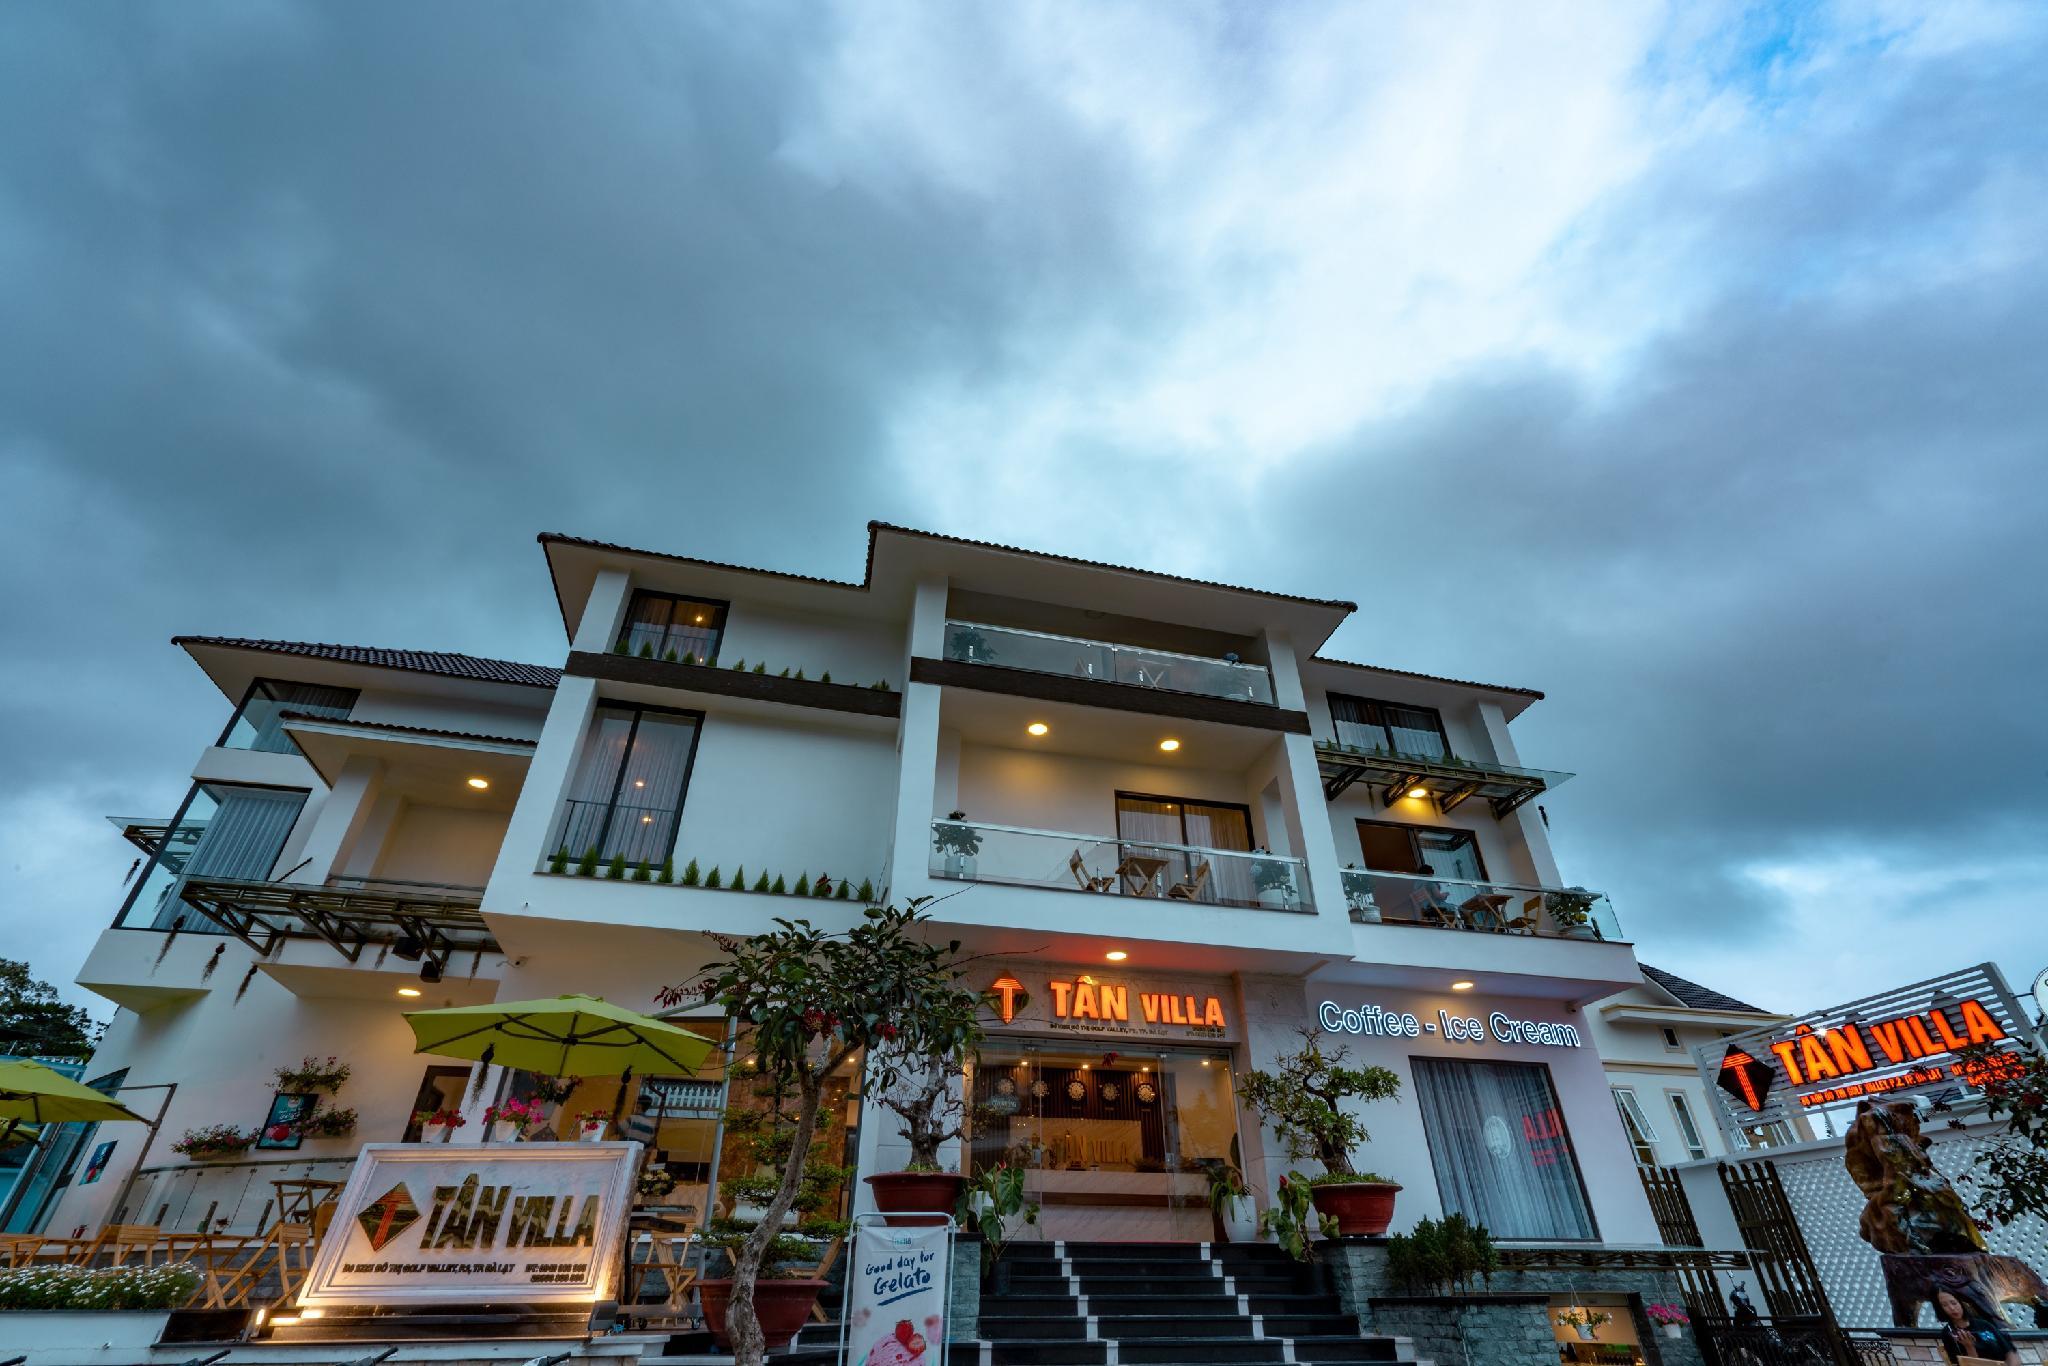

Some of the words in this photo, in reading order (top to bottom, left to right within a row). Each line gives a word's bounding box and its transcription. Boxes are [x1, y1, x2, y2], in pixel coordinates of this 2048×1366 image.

[1050, 975, 1128, 1021] TÂN
[1140, 993, 1226, 1026] VILLA
[1319, 1000, 1420, 1037] Coffee
[1439, 1009, 1484, 1040] Ice
[1489, 1012, 1581, 1048] Cream
[1770, 1023, 1876, 1086] TÂN
[1870, 1000, 2009, 1064] VILLA
[420, 1173, 512, 1249] TÂN
[506, 1195, 599, 1248] VILLA
[402, 1263, 427, 1273] GOLF
[866, 1257, 892, 1275] Good
[897, 1255, 915, 1270] day
[874, 1267, 931, 1295] Gelato
